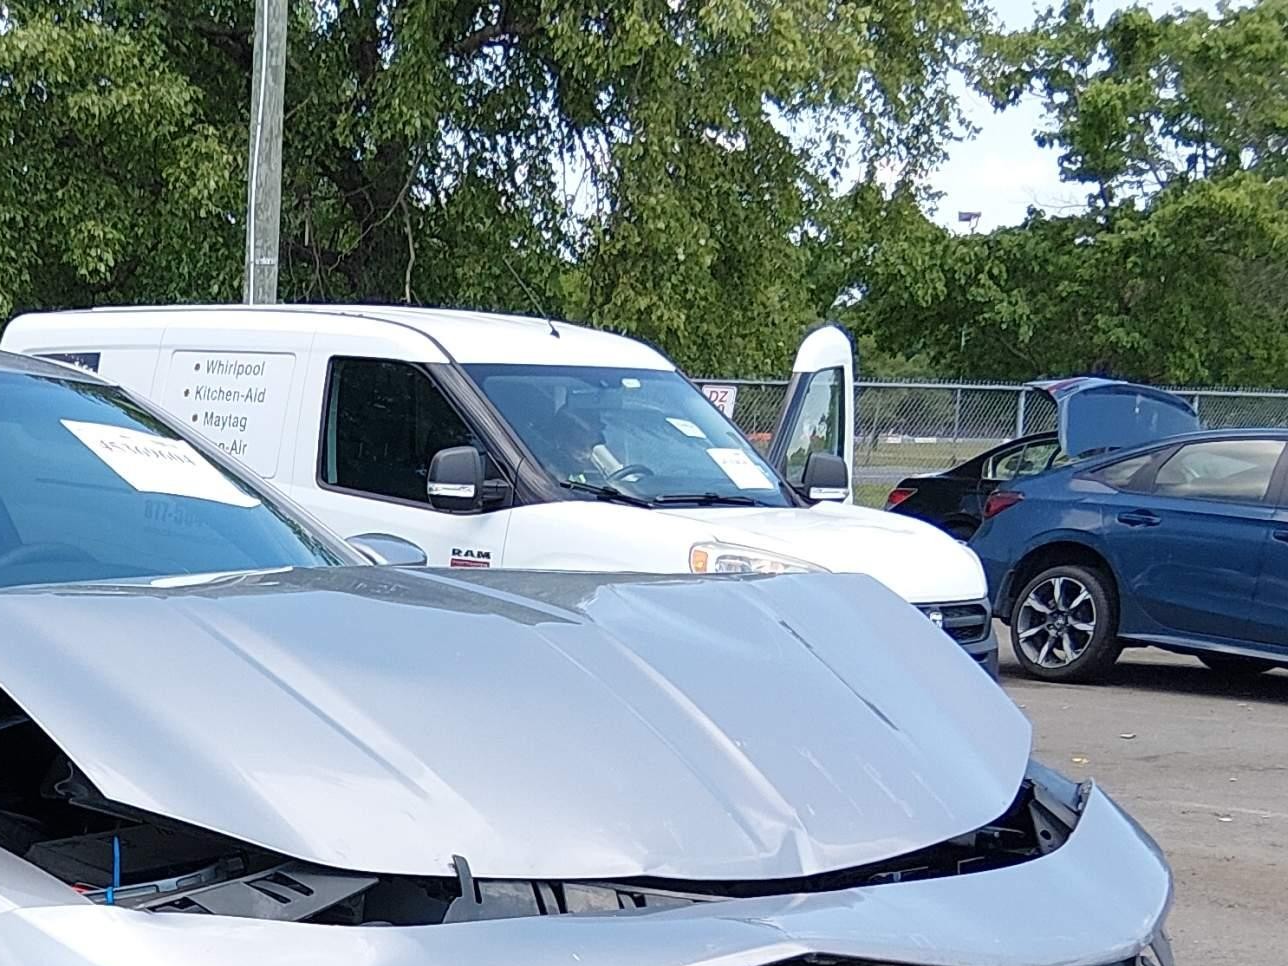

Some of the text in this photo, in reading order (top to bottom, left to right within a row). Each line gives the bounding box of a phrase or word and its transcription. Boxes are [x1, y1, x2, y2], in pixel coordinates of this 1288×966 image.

[206, 359, 266, 380] Whirlpool
[194, 385, 267, 403] Kitchen-Aid
[203, 411, 248, 432] Maytag
[452, 548, 491, 559] RAM
